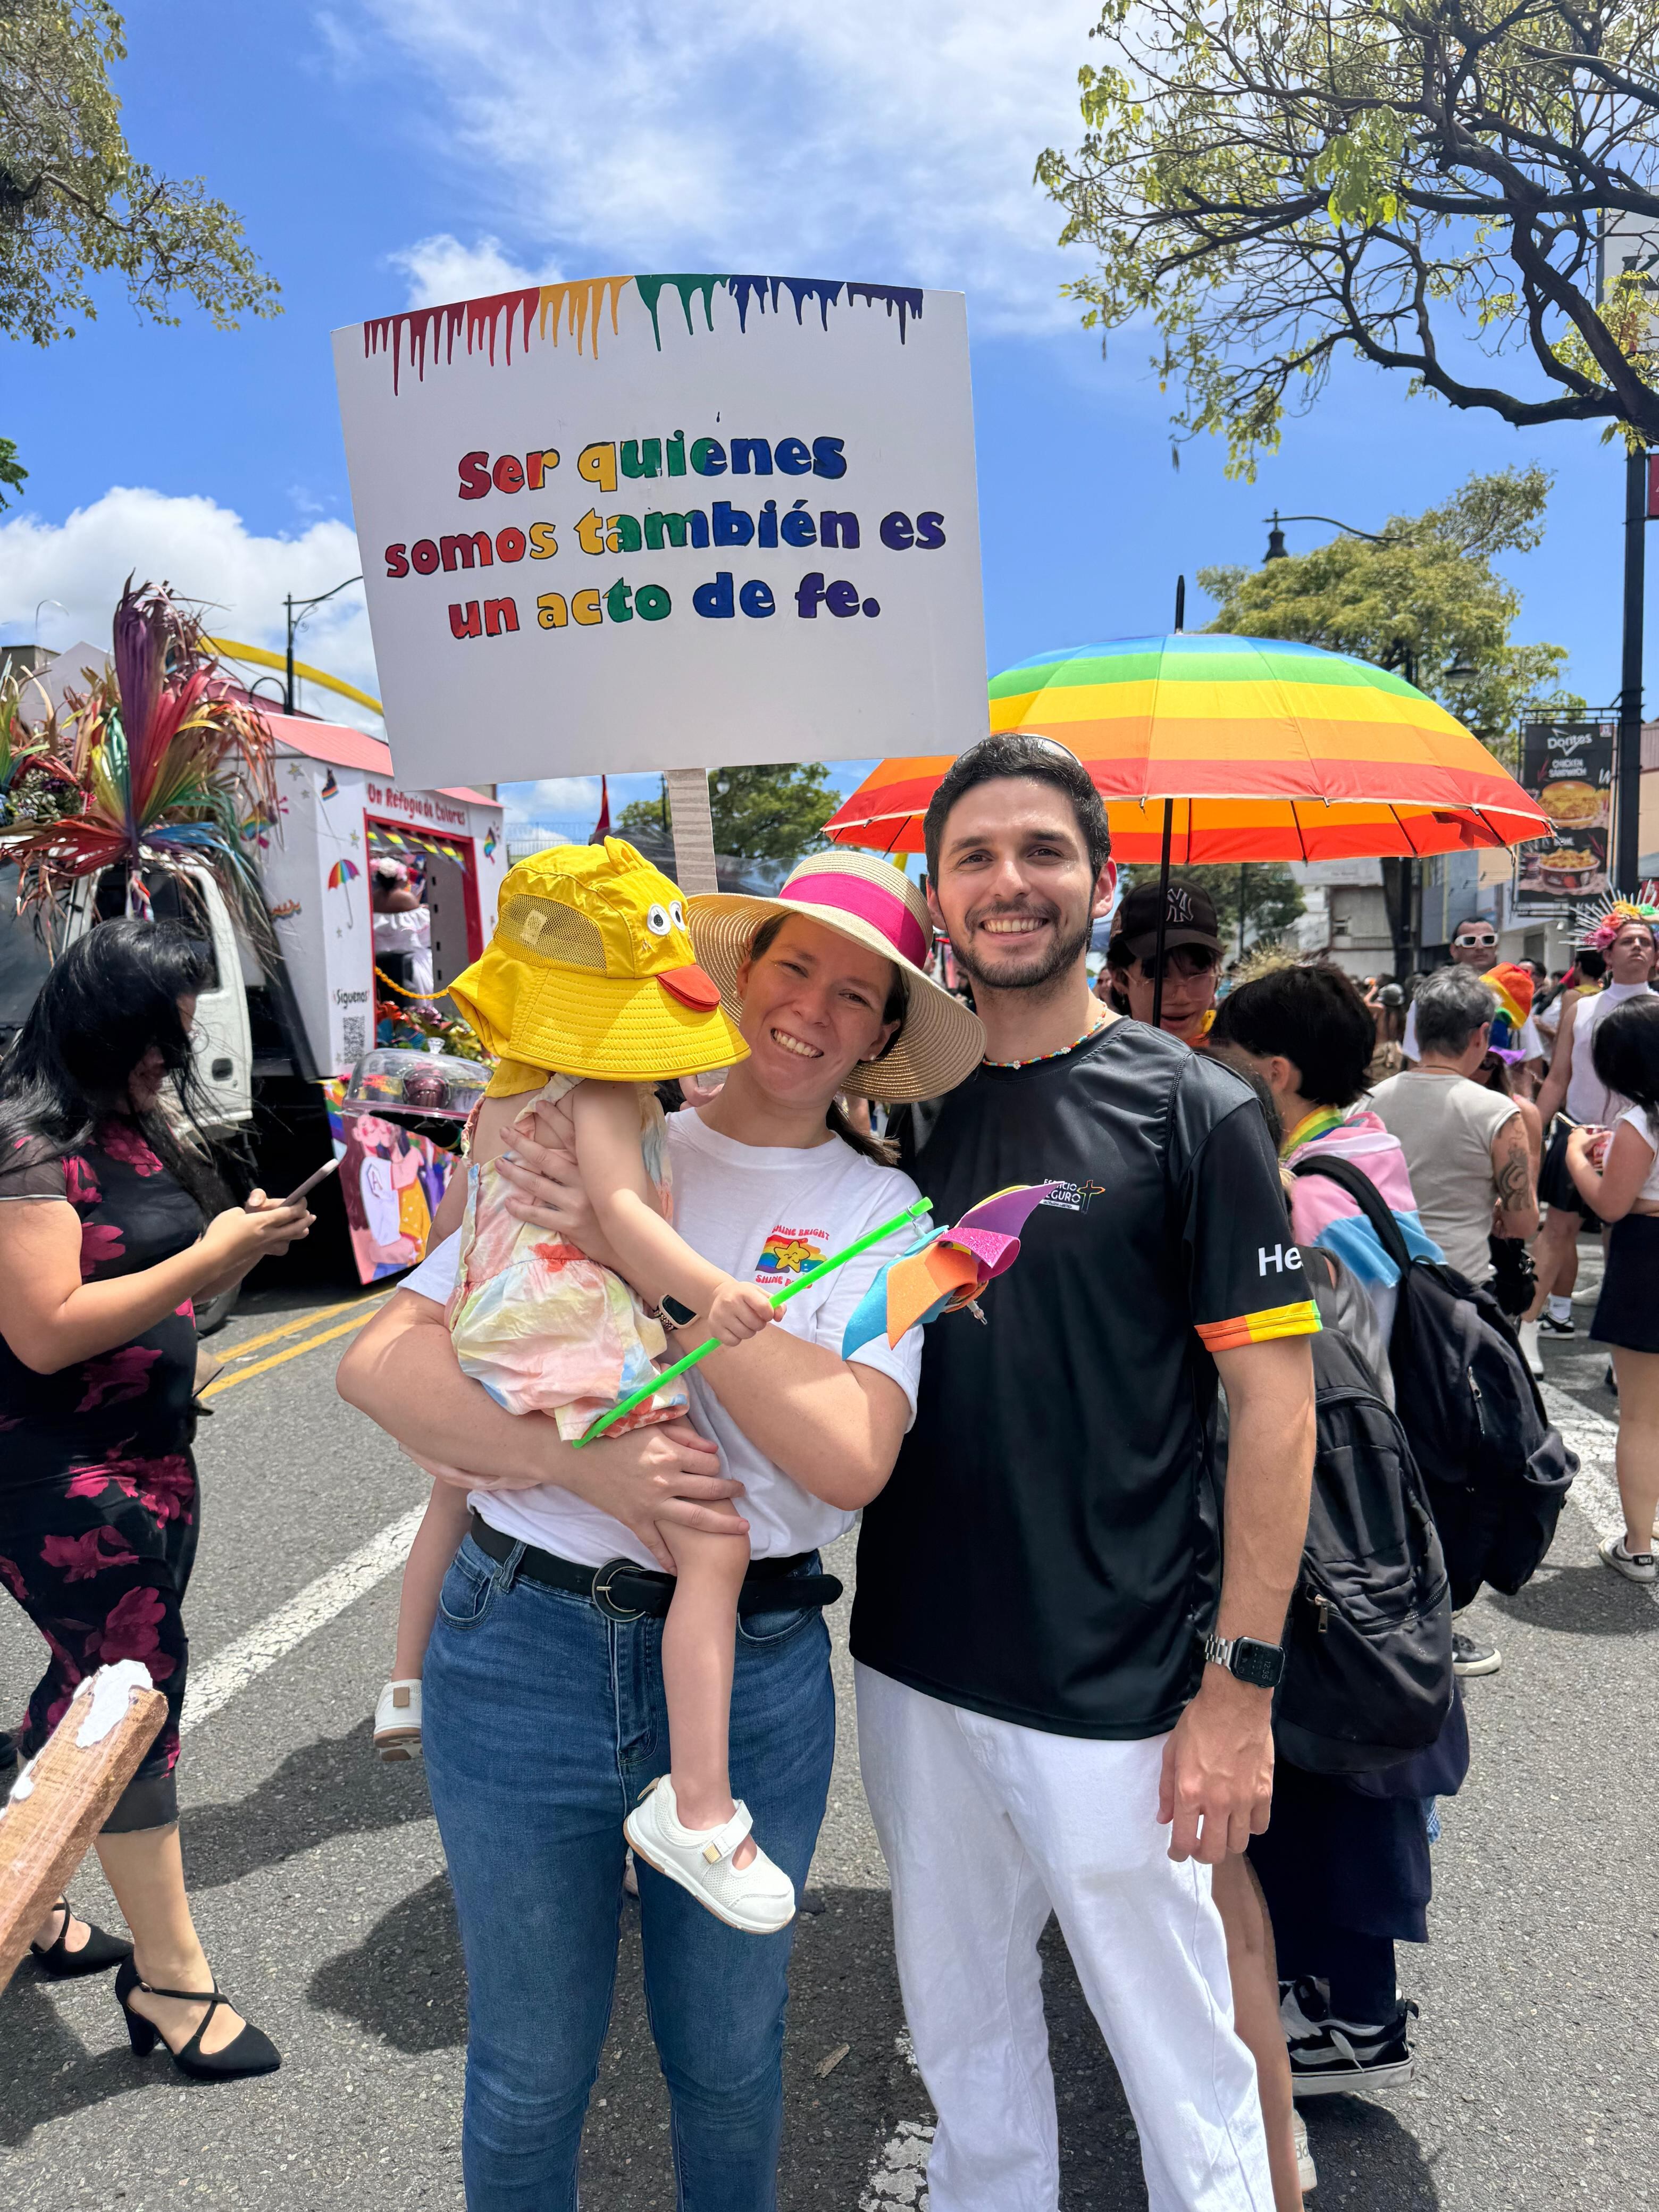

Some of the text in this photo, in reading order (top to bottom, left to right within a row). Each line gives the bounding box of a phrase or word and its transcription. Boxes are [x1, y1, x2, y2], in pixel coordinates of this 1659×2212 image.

[458, 430, 847, 500] Ser quienes
[384, 499, 946, 579] somos también es
[448, 572, 881, 640] un acto de fe.
[1547, 733, 1593, 750] Doritos
[1552, 758, 1583, 769] CHICKEN
[368, 783, 382, 805] Un
[386, 787, 423, 819] Refugio
[435, 801, 466, 826] Colores
[1044, 1179, 1077, 1191] ESACIO
[1045, 1189, 1081, 1203] GURO
[798, 1229, 830, 1241] BRIGHT
[755, 1275, 783, 1285] SHINE
